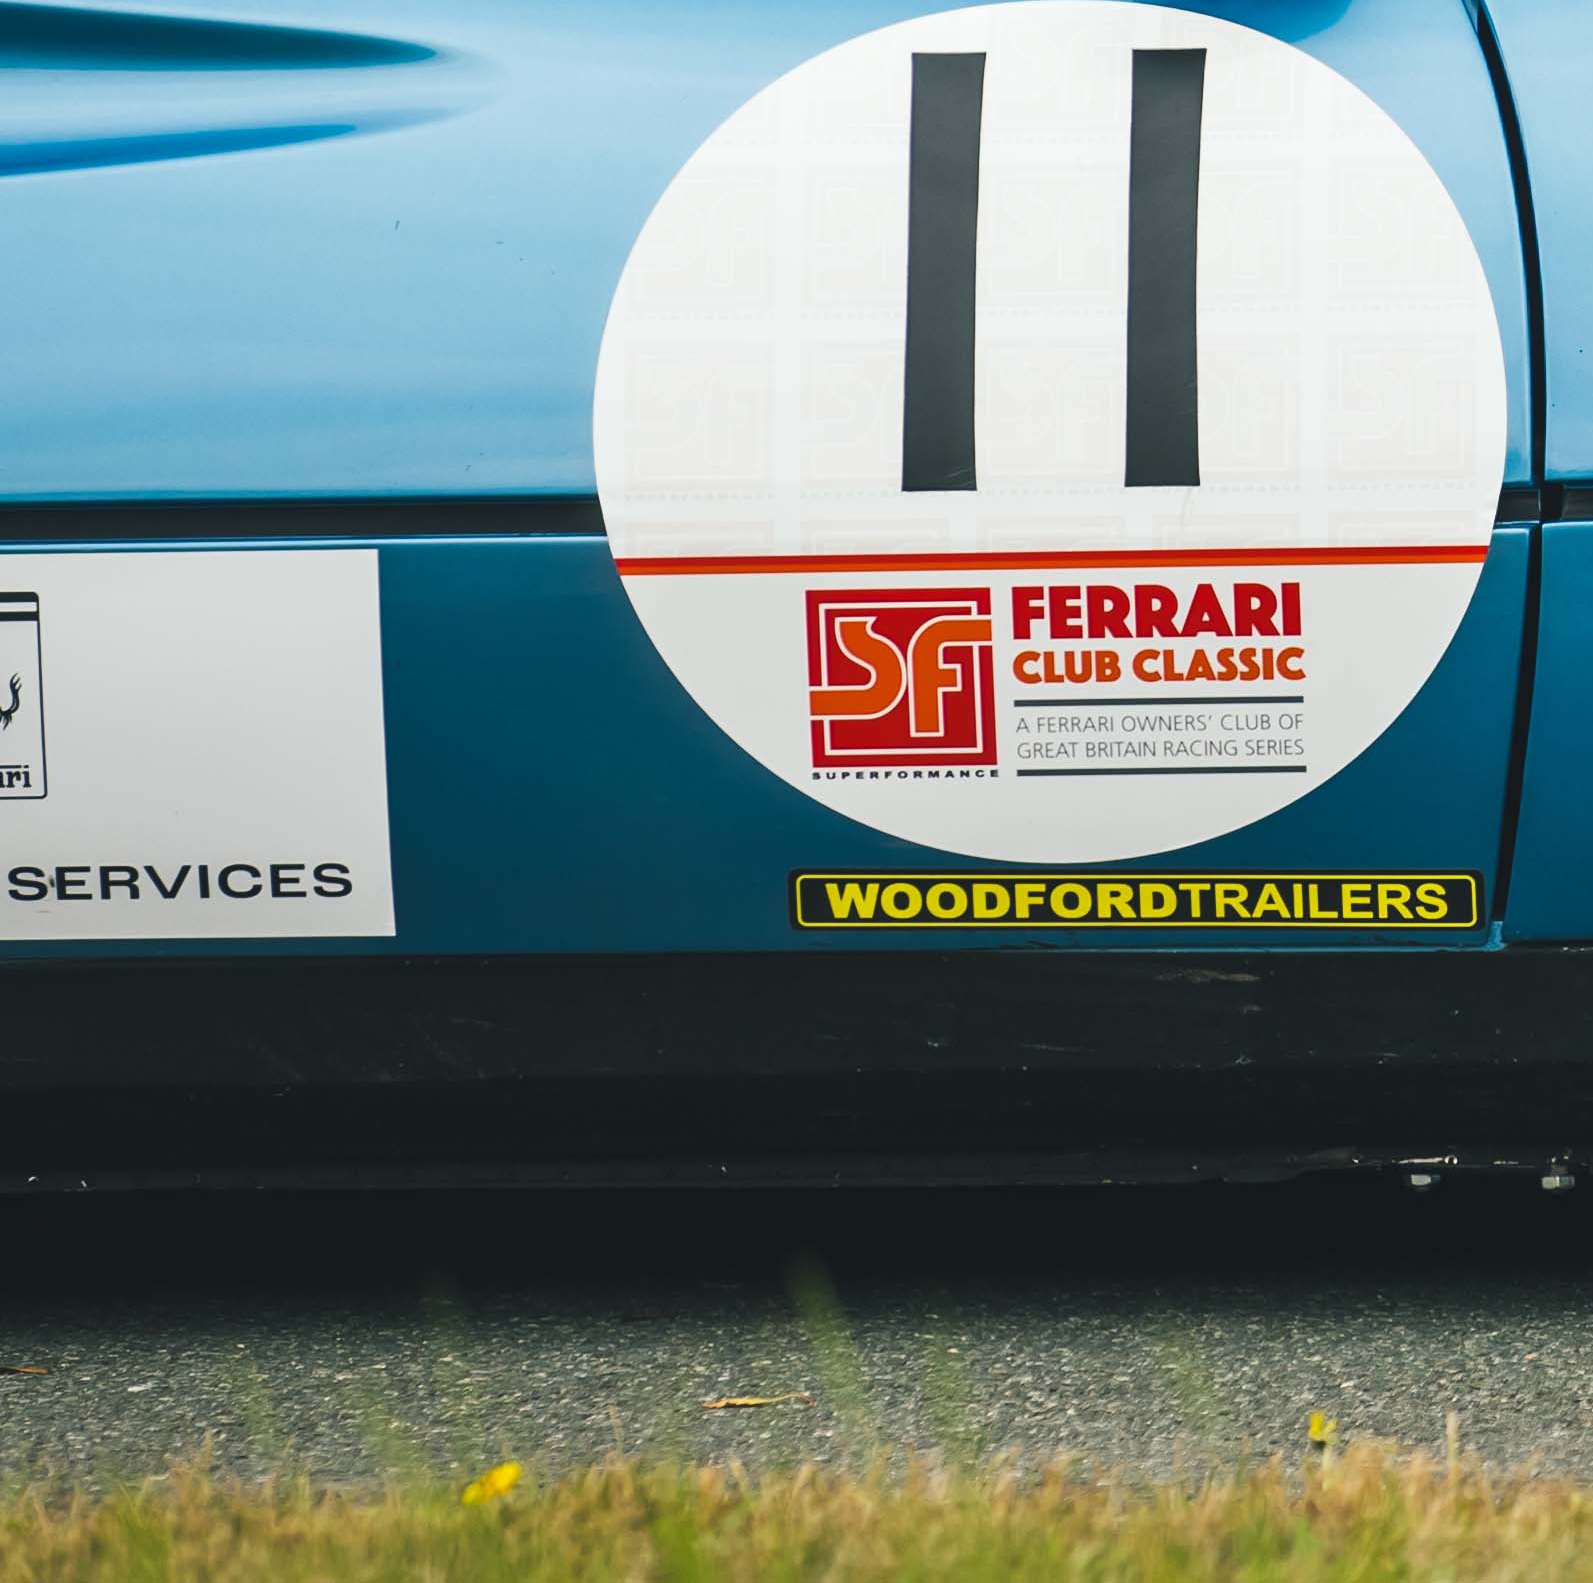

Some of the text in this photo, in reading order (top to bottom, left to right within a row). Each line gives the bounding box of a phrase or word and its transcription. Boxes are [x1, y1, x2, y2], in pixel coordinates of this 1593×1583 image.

[902, 48, 1207, 492] 11
[1012, 582, 1302, 640] FERRARI
[1012, 647, 1306, 684] CLUB CLASSIC
[1016, 717, 1030, 733] A
[1037, 716, 1115, 733] FERRARI
[1221, 714, 1271, 731] CLUB
[1278, 713, 1304, 730] OF
[1017, 739, 1304, 759] GREAT BRITAIN RACING SERIES
[812, 769, 999, 780] SUPERFORMANCE
[8, 863, 353, 901] SERVICES
